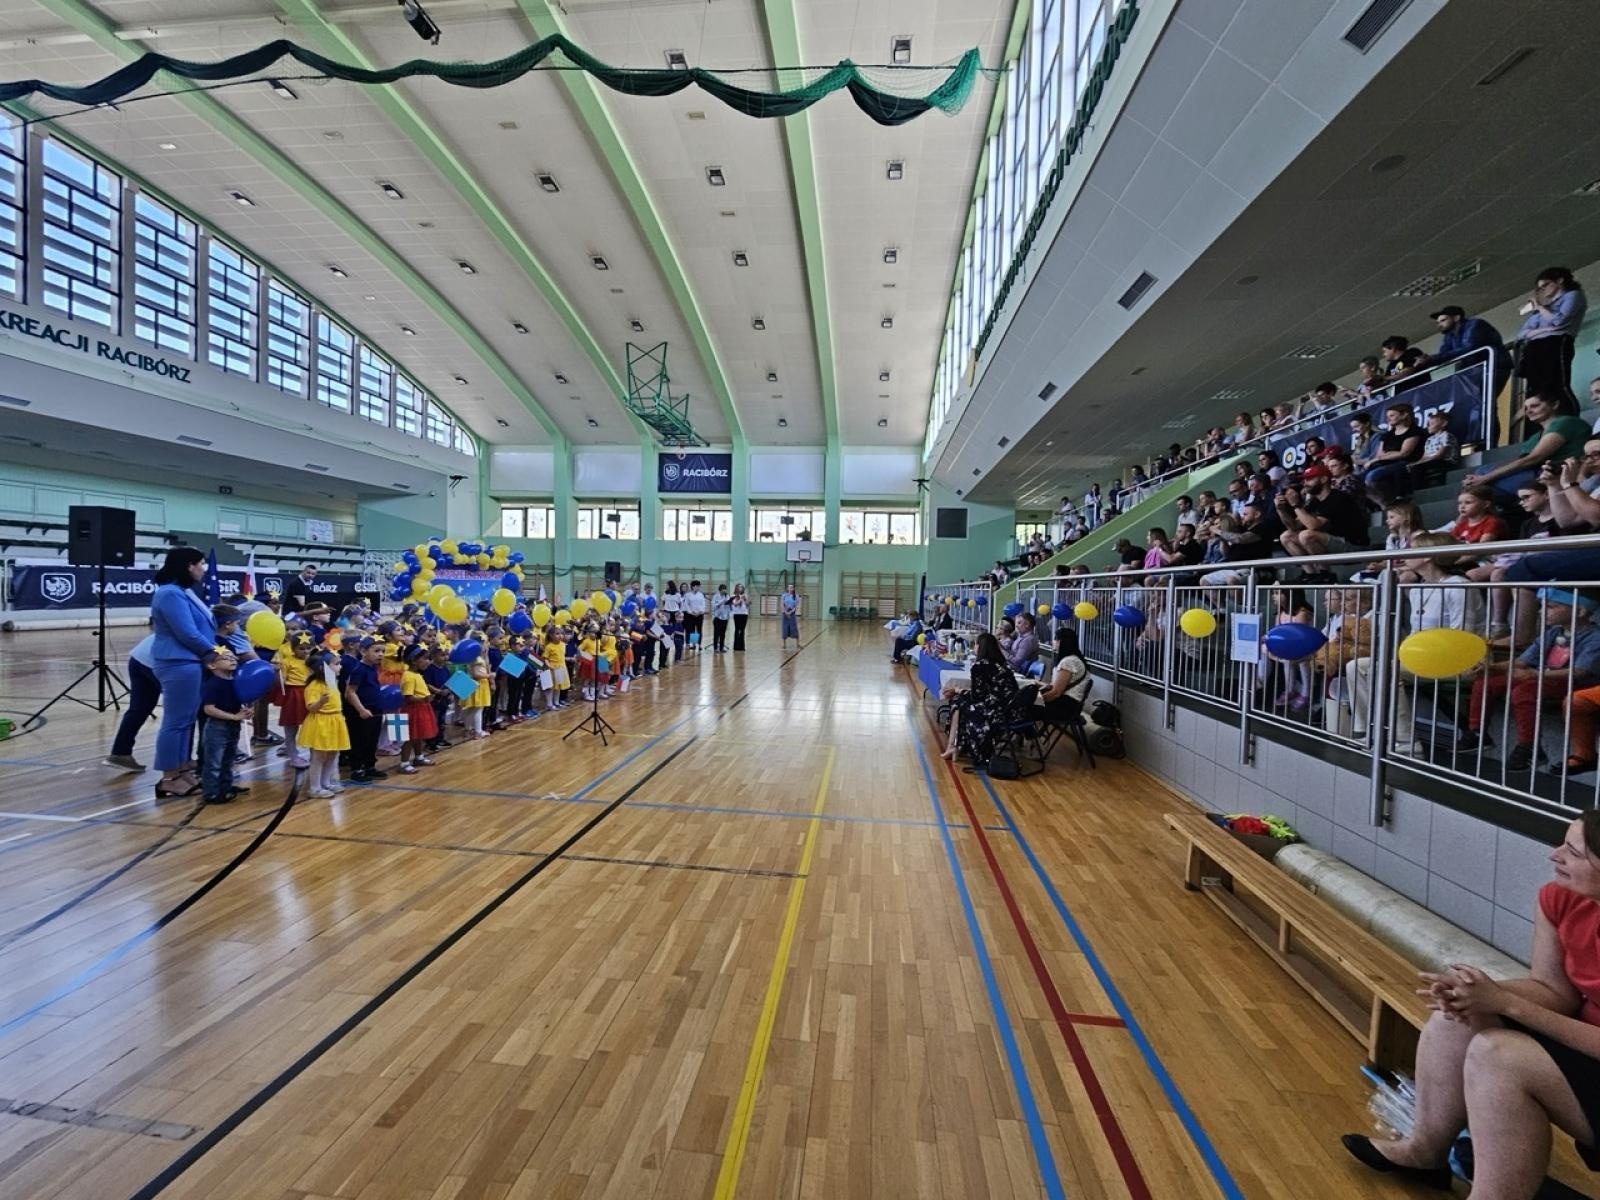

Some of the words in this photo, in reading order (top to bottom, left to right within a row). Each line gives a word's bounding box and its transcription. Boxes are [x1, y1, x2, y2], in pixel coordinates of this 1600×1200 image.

[97, 341, 191, 383] RACIBÓRZ
[1282, 443, 1306, 469] OS
[683, 467, 728, 477] RACIBÓRZ
[92, 579, 159, 594] RACIBÓ
